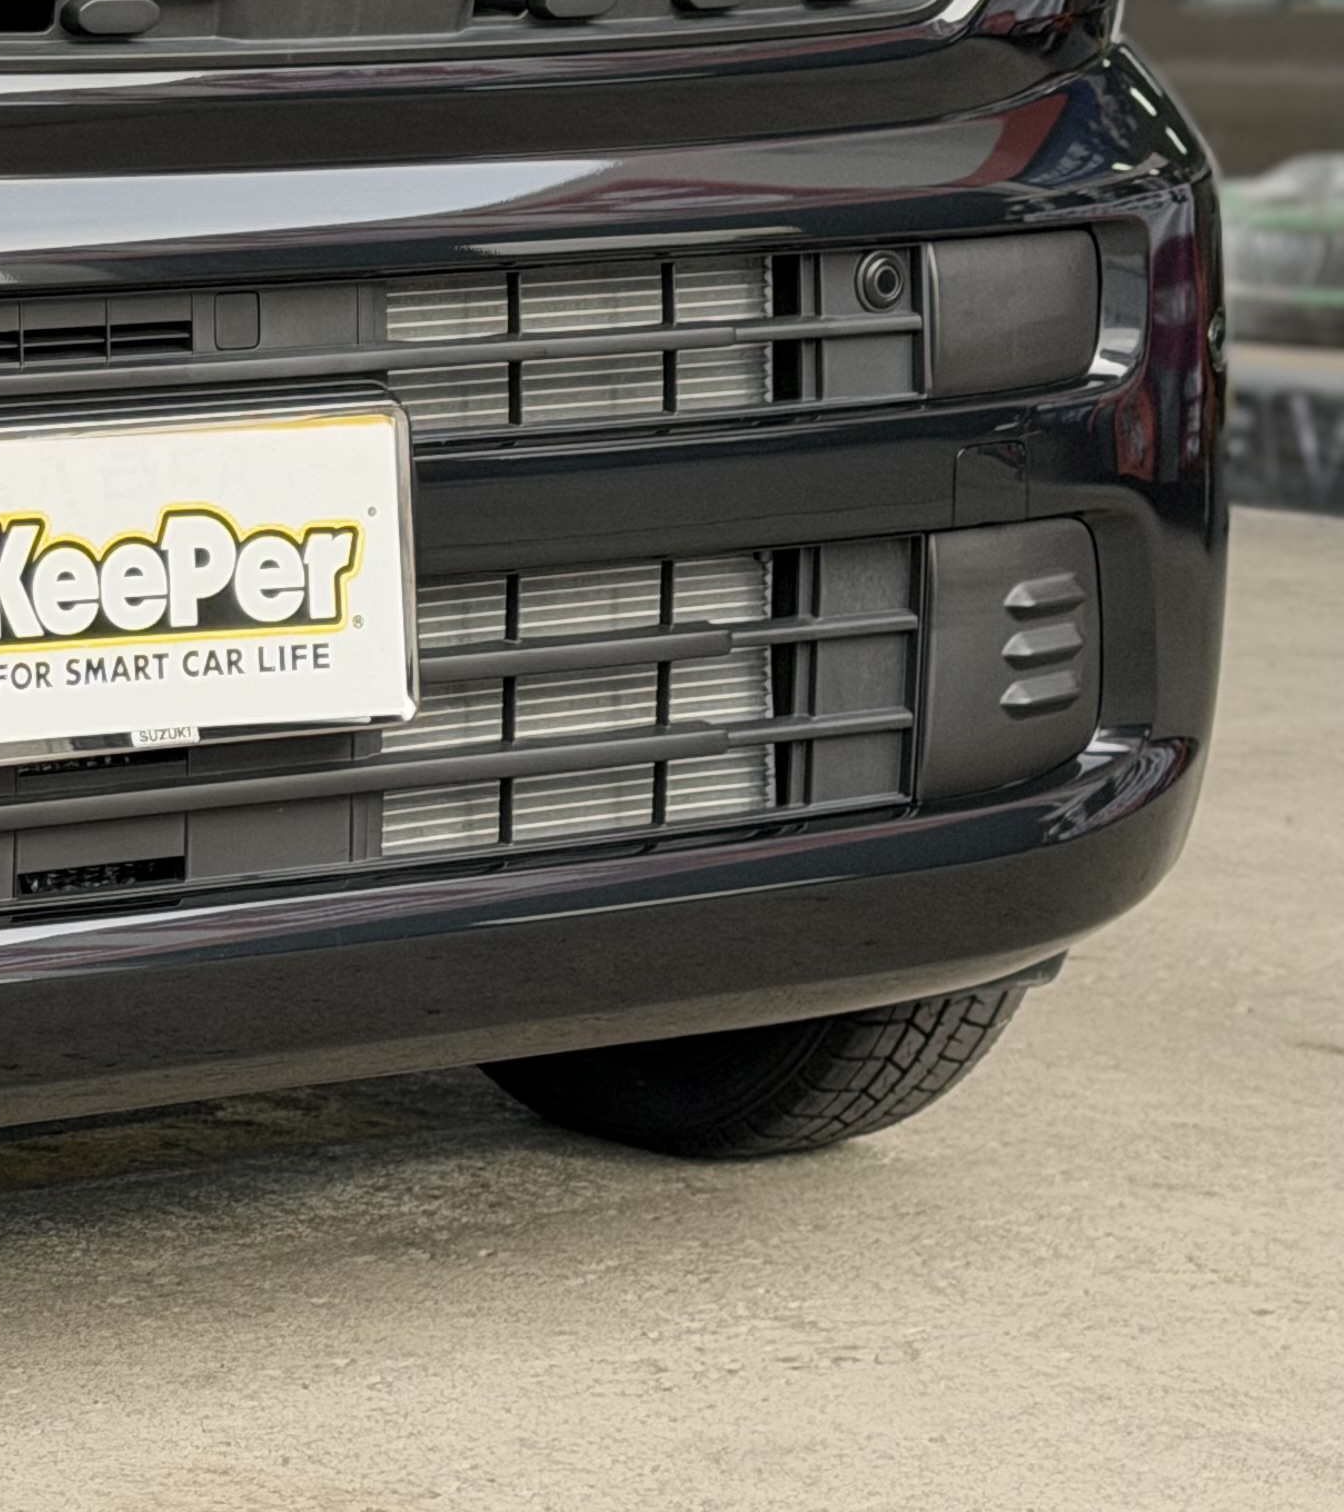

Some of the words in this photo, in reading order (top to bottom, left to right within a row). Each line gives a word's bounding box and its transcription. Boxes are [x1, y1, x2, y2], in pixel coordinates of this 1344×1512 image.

[65, 652, 170, 686] SMART
[182, 647, 245, 678] CAR
[258, 642, 331, 673] LIFE
[139, 726, 192, 743] SUZUKI
